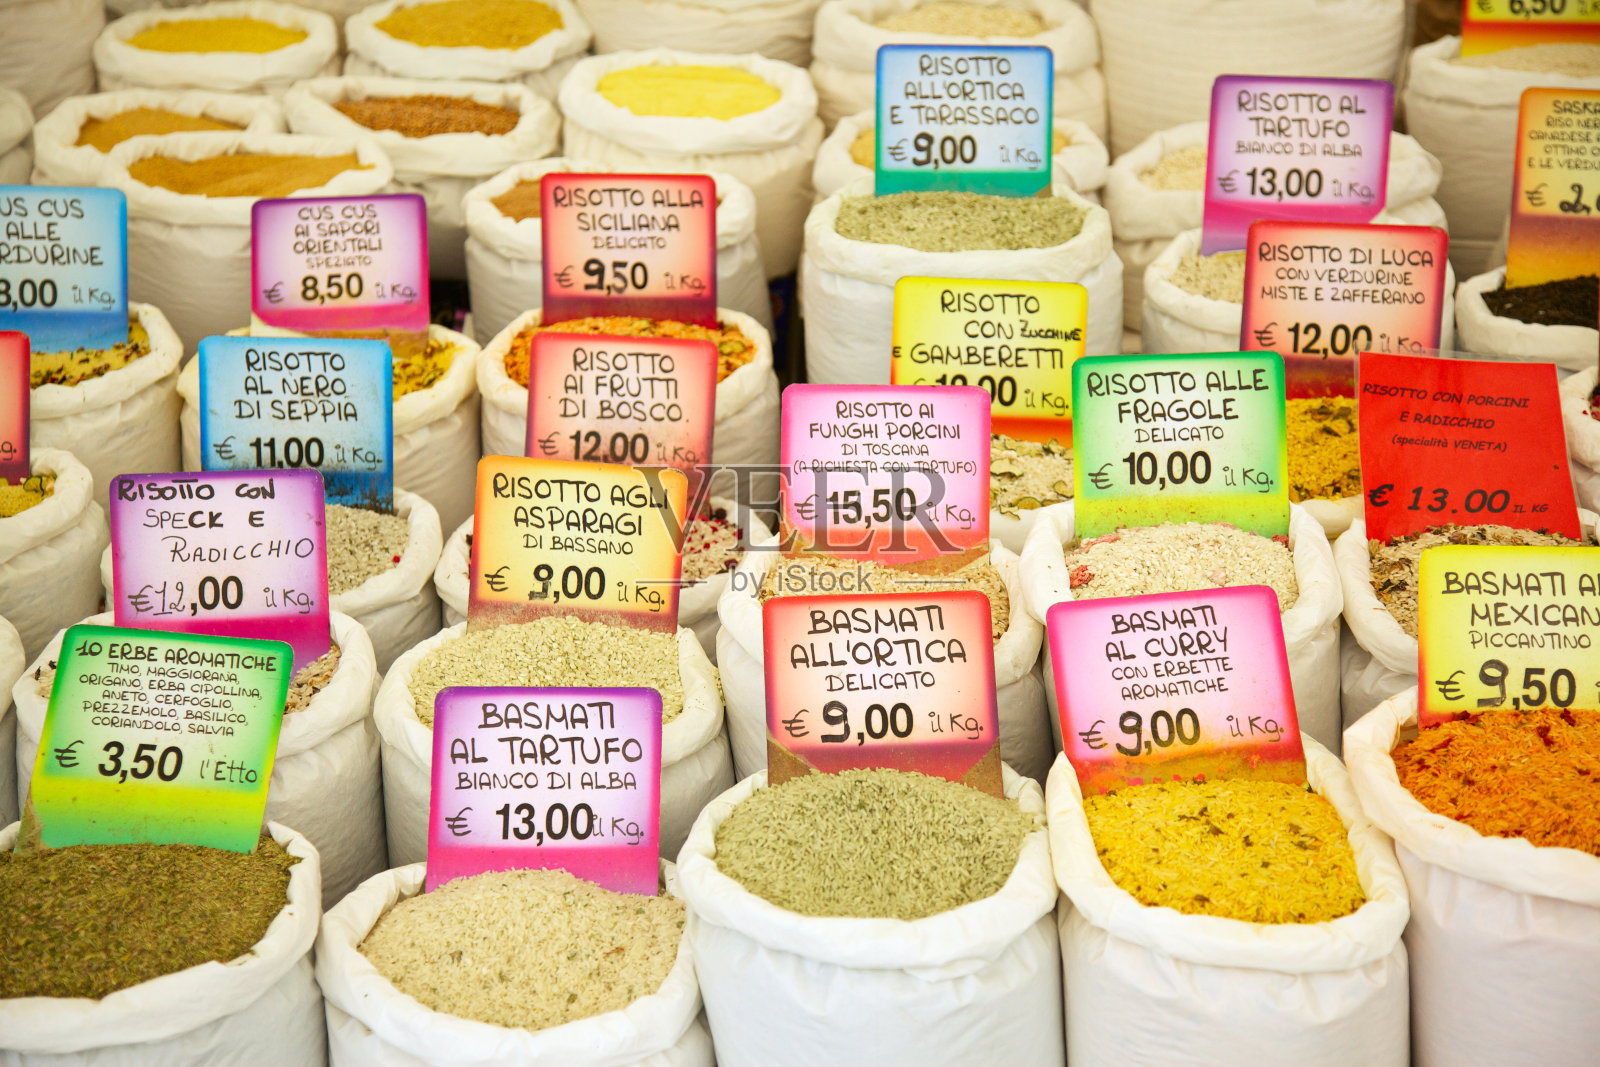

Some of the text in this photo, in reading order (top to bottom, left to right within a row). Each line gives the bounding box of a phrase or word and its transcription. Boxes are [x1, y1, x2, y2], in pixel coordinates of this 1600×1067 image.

[919, 54, 1011, 76] RISOTTO
[904, 79, 1024, 101] ALL'ORTICA
[1238, 90, 1366, 114] RISOTTO AL
[890, 103, 1040, 126] E TARASSACO
[1546, 115, 1573, 127] RISO
[1249, 116, 1350, 138] TARTUFO
[912, 131, 977, 170] 9,00
[1235, 141, 1363, 158] BIANCO DI ALBA
[1246, 167, 1323, 201] 13,00
[38, 198, 84, 219] CUS
[553, 186, 704, 208] RISOTTO ALLA
[298, 204, 377, 221] CUS CUS
[577, 212, 680, 232] SICILIANA
[6, 221, 61, 241] ALLE
[295, 220, 380, 237] AI SAPORI
[293, 238, 382, 254] ORIENTALI
[593, 236, 667, 249] DELICATO
[1258, 242, 1433, 267] RISOTTO DI LUCA
[306, 255, 372, 269] SPEZIATO
[301, 272, 363, 304] 8,50
[584, 258, 648, 296] 9,50
[1276, 267, 1412, 286] CON VERDURINE
[941, 289, 1040, 314] RISOTTO
[1261, 286, 1425, 304] MISTE E ZAFFERANO
[964, 320, 1013, 339] CON
[1288, 322, 1372, 360] 12,00
[245, 348, 345, 373] RISOTTO
[573, 347, 675, 374] RISOTTO
[892, 343, 1064, 368] E GAMBERETTI
[244, 374, 346, 398] AL NERO
[564, 374, 678, 399] AI FRUTTI
[1087, 369, 1269, 397] RISOTTO ALLE
[1363, 383, 1530, 408] RISOTTO CON PORCINI
[234, 399, 358, 423] DI SEPPIA
[559, 398, 682, 421] DI BOSCO
[836, 400, 935, 419] RISOTTO AI
[1118, 398, 1239, 423] FRAGOLE
[1400, 411, 1495, 429] E RADICCHIO
[809, 421, 960, 440] FUNGHI PORCINI
[1135, 426, 1224, 443] DELICATO
[842, 443, 929, 456] DI TOSCANA
[1454, 439, 1507, 453] VENETA)
[812, 459, 878, 473] RICHIESTA
[882, 460, 910, 473] CON
[1122, 451, 1212, 490] 10,00
[118, 478, 275, 501] RISOTTO CON
[493, 473, 668, 509] RISOTTO AGLI
[1407, 486, 1510, 514] 13.00
[143, 509, 265, 529] SPECK E
[826, 488, 917, 529] 15,50
[514, 506, 642, 536] ASPARAGI
[161, 535, 314, 562] RADICCHIO
[523, 534, 633, 555] DI BASSANO
[528, 564, 606, 604] 9,00
[1442, 571, 1566, 597] BASMATI
[808, 605, 944, 634] BASMATI
[1111, 605, 1217, 634] BASMATI
[1105, 627, 1228, 662] AL CURRY
[1469, 631, 1591, 649] PICCANTINO
[75, 640, 277, 671] 10 ERBE AROMATICHE
[790, 637, 967, 669] ALL'ORTICA
[107, 662, 240, 683] TIMO, MAGGIORANA,
[1111, 657, 1233, 680] CON ERBETTE
[79, 674, 263, 700] ORIGANO, ERBA CIPOLLINA,
[825, 671, 935, 692] DELICATO
[1122, 677, 1229, 700] AROMATICHE
[1477, 659, 1576, 710] 9,50
[102, 690, 234, 711] ANETO, CERFOGLIO,
[82, 700, 249, 726] PREZZEMOLO, BASILICO,
[478, 702, 615, 730] BASMATI
[820, 700, 914, 746] 9,00
[91, 716, 234, 736] CORIANDOLO, SALVIA
[1115, 707, 1201, 757] 9,00
[450, 734, 643, 765] AL TARTUFO
[98, 741, 183, 784] 3,50
[455, 772, 637, 790] BIANCO DI ALBA
[495, 803, 594, 846] 13,00
